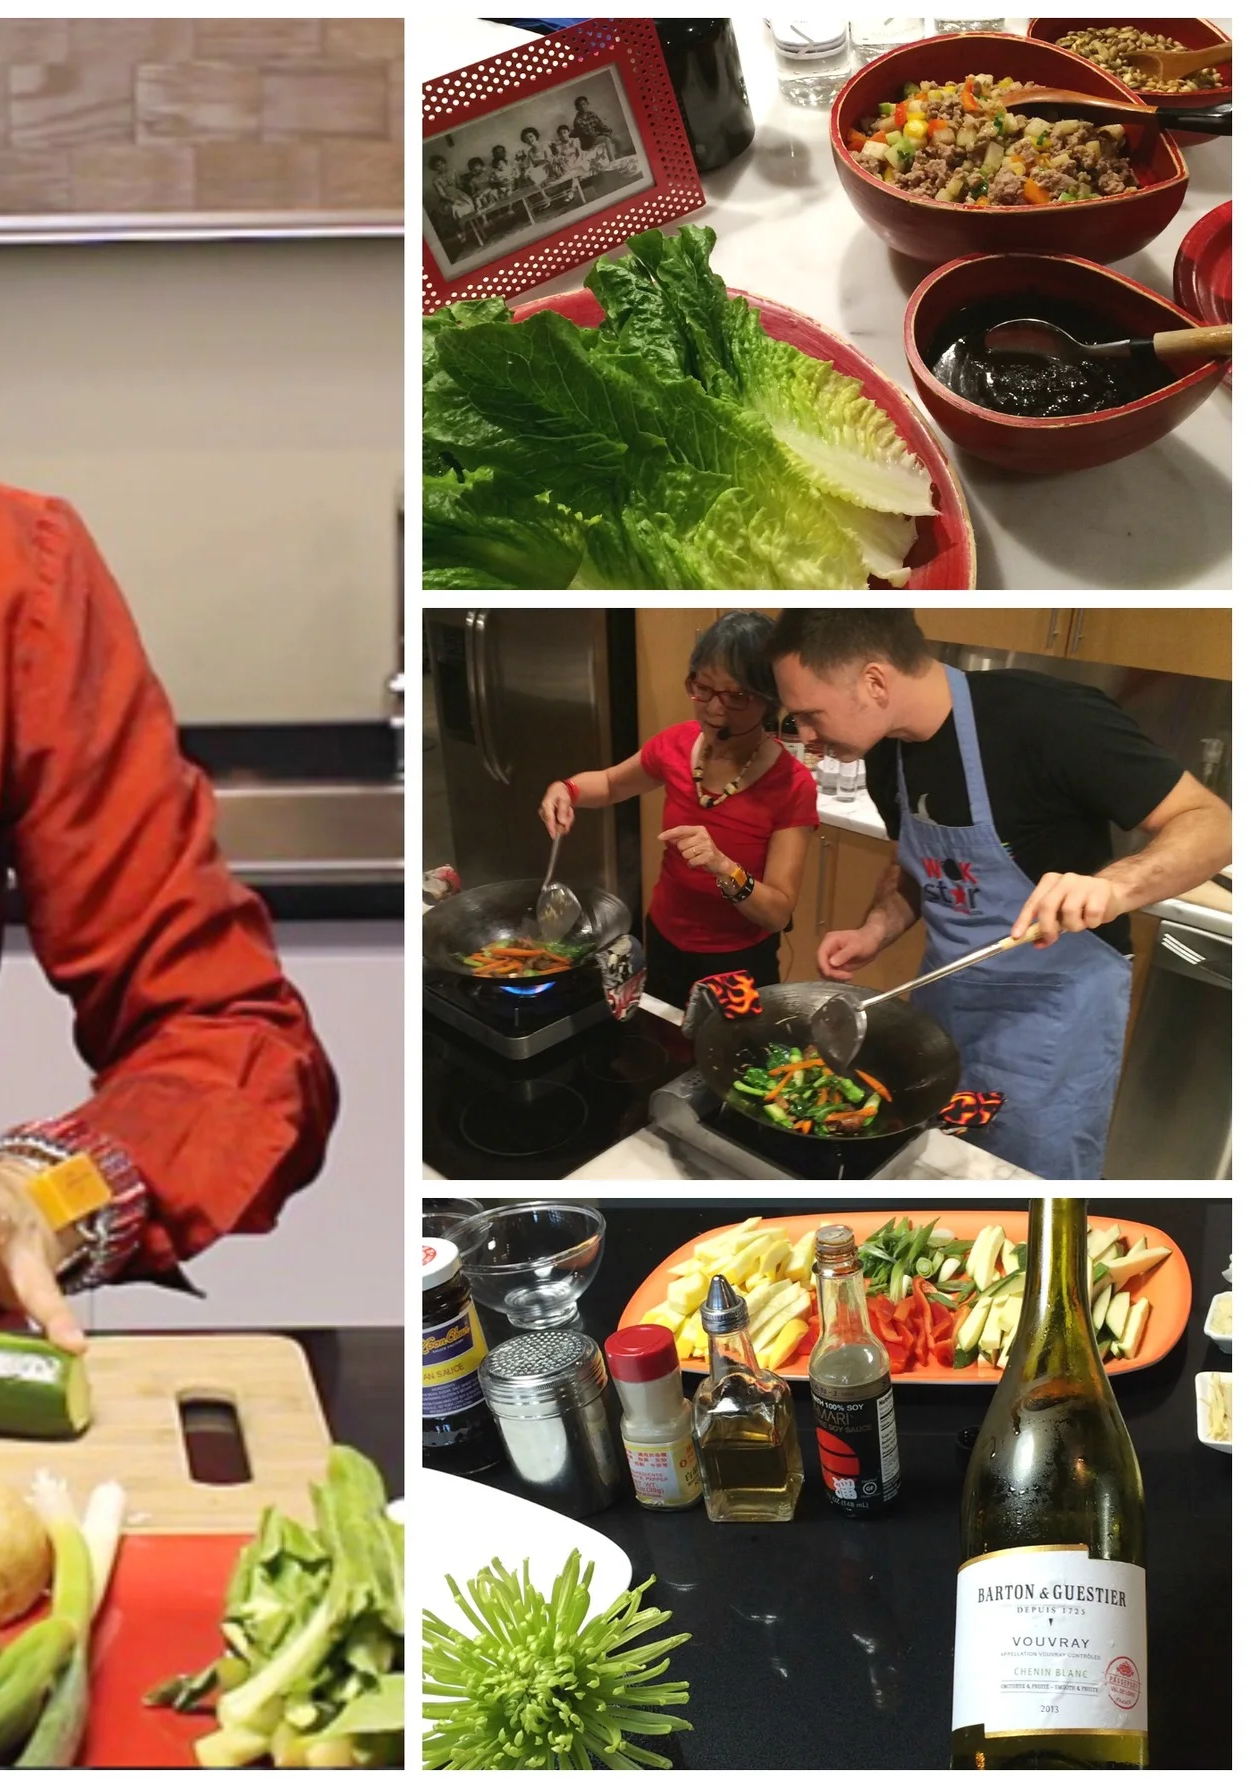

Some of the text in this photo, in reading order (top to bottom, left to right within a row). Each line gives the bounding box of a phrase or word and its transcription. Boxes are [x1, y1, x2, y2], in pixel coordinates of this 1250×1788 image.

[436, 1363, 465, 1377] SAUCE
[825, 1402, 845, 1411] 100%
[978, 1584, 1127, 1608] BARTON & GUESTIER
[1012, 1636, 1090, 1649] VOUVRAY
[1014, 1667, 1088, 1678] CHENIN BLANC
[1040, 1705, 1059, 1714] 2013
